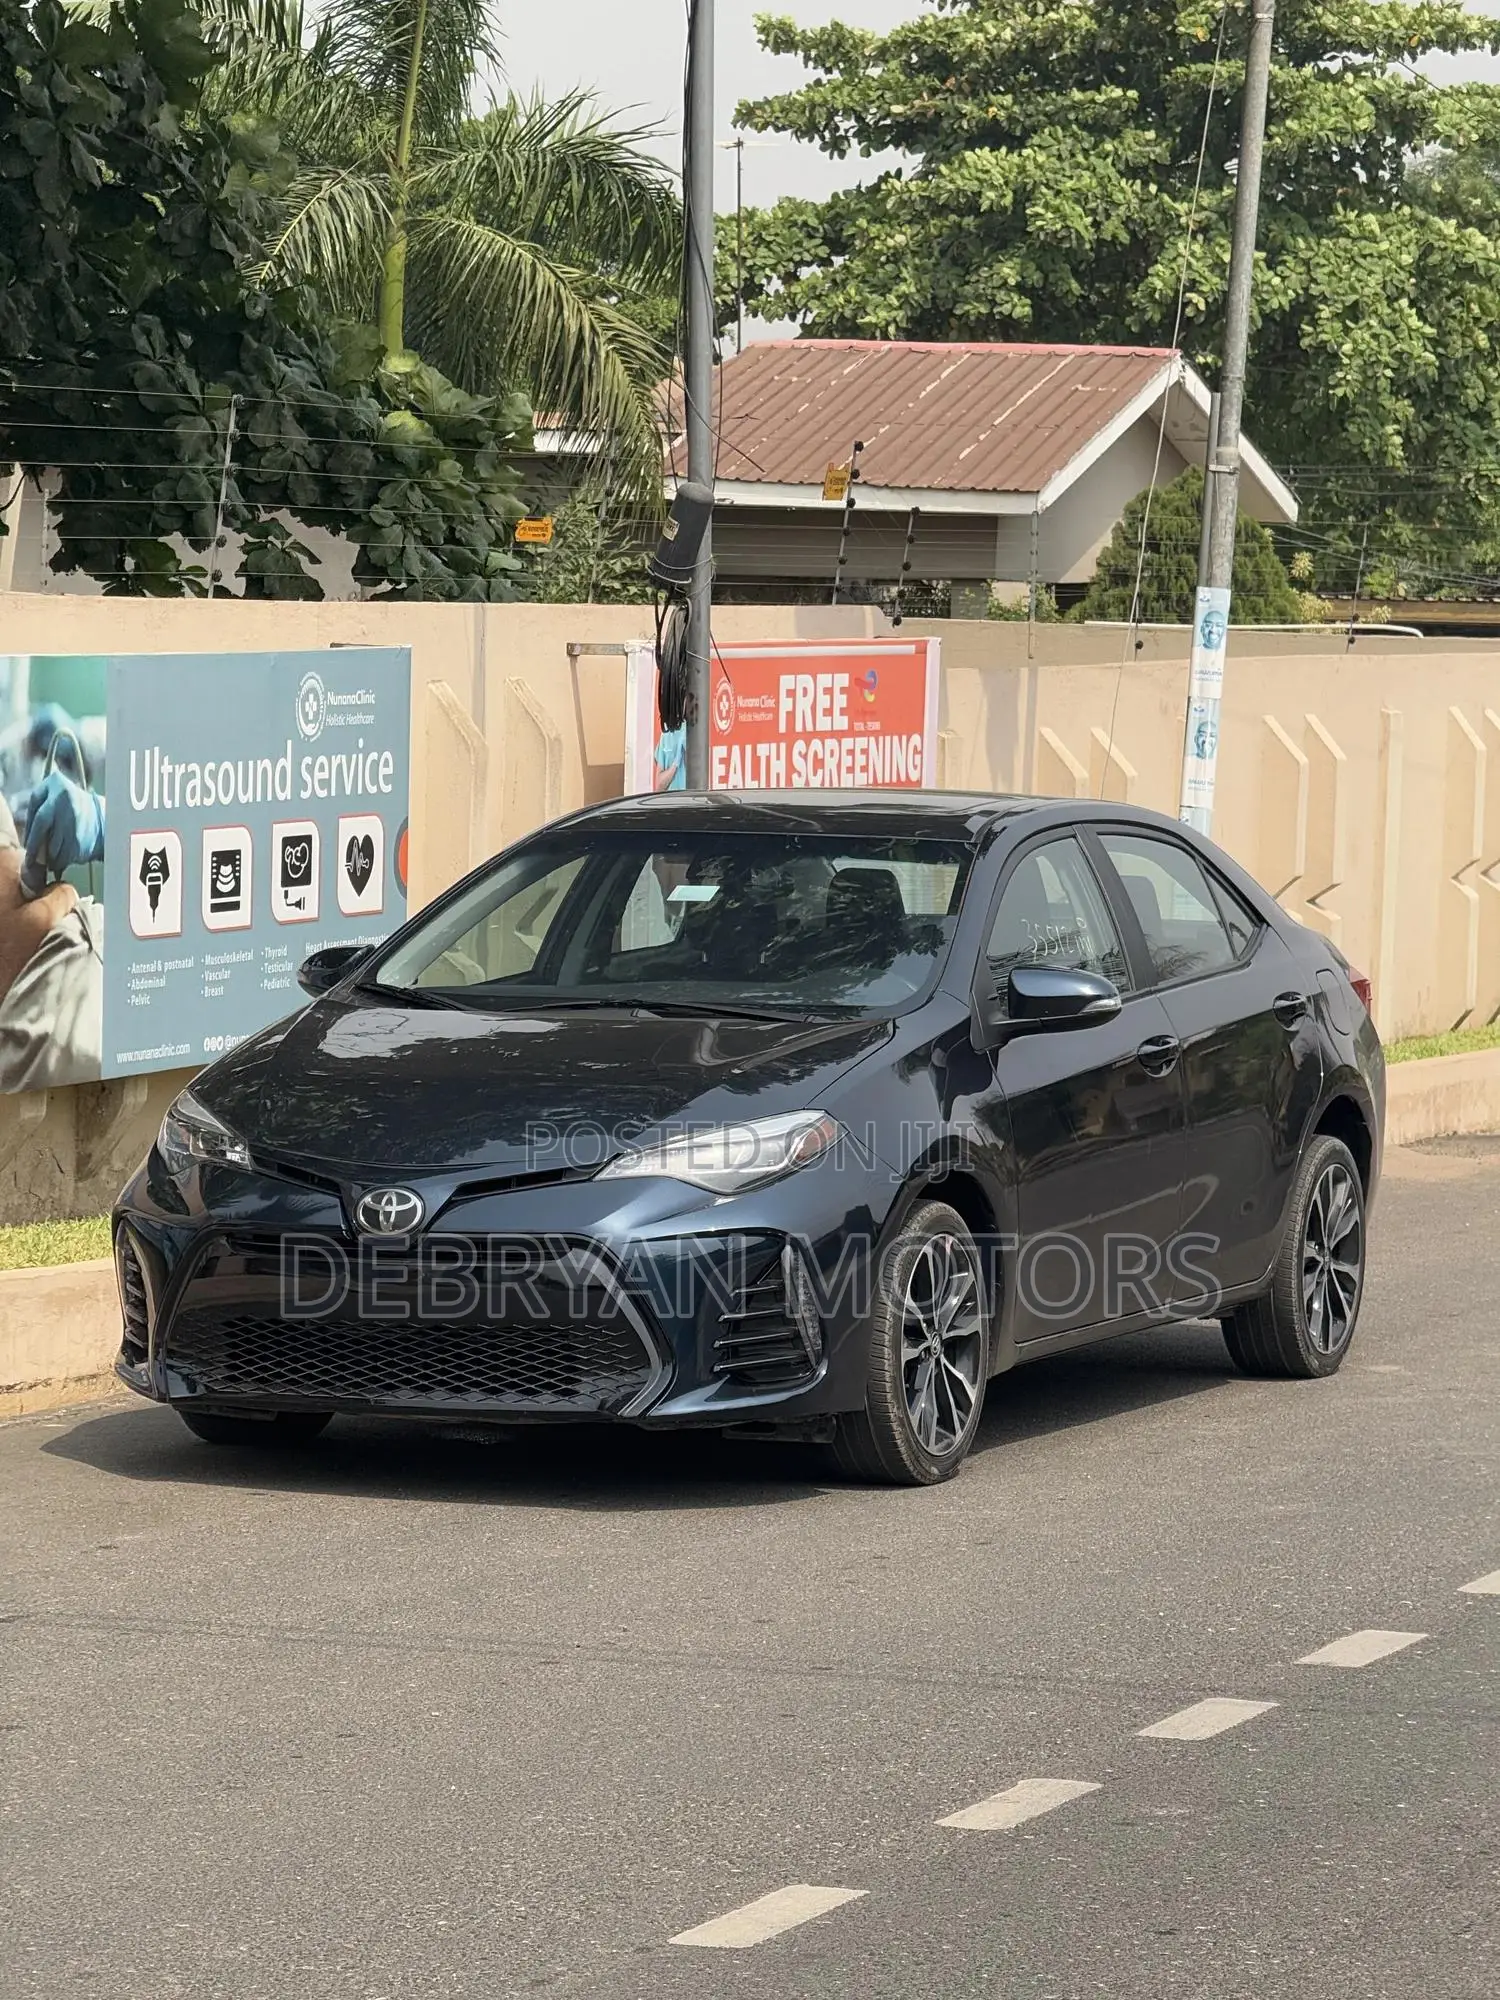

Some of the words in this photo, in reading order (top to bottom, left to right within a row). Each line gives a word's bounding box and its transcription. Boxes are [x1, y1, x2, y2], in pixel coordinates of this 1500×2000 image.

[327, 689, 376, 706] NunanaClinic
[778, 673, 850, 733] FREE
[325, 713, 345, 727] Holistic
[345, 712, 375, 726] Healthcare
[711, 742, 787, 789] EALTH
[791, 733, 922, 787] SCREENING
[130, 739, 292, 811] Ultrasound
[300, 738, 393, 800] service
[264, 945, 288, 960] Thyroid
[305, 941, 322, 953] Heart
[157, 960, 162, 972] &
[164, 956, 194, 973] postnatal
[204, 948, 254, 966] Musculoskeletal
[204, 969, 231, 982] Vascular
[264, 962, 294, 974] Testicular
[131, 976, 166, 991] Abdominal
[263, 977, 291, 990] Pediatric
[204, 985, 224, 998] Breast
[131, 994, 151, 1006] Pelvic
[116, 1042, 191, 1064] www.nunanaclinic.com
